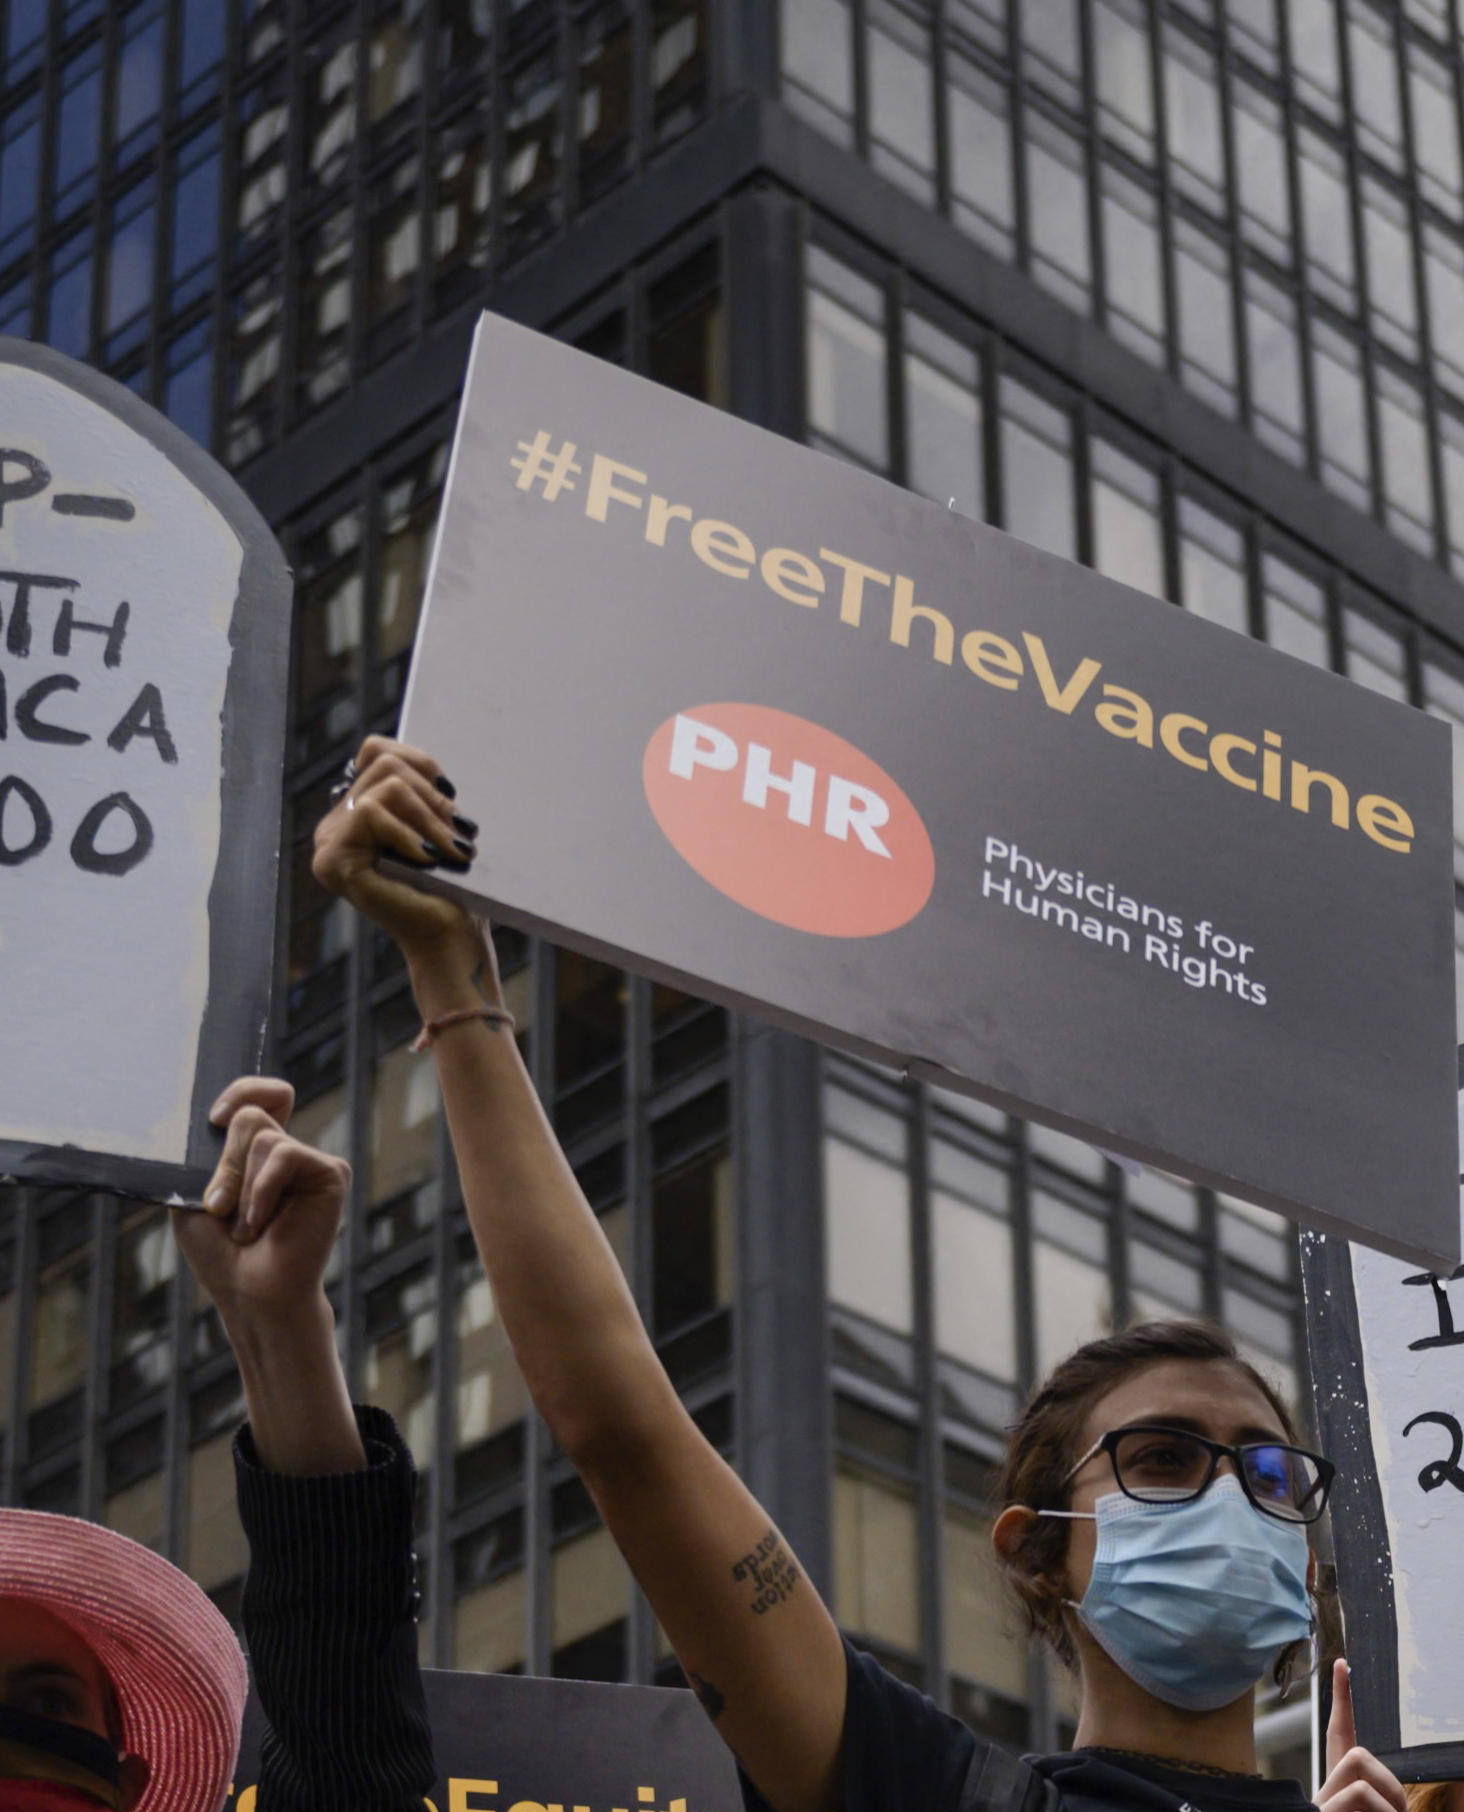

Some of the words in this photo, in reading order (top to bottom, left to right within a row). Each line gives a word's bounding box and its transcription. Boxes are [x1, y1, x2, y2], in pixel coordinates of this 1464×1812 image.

[510, 429, 1416, 855] #FreeTheVaccine
[668, 712, 894, 861] PHR
[981, 868, 1132, 954] Human
[1142, 934, 1269, 1008] Rights
[983, 836, 1184, 944] Physicians
[1193, 916, 1256, 963] for
